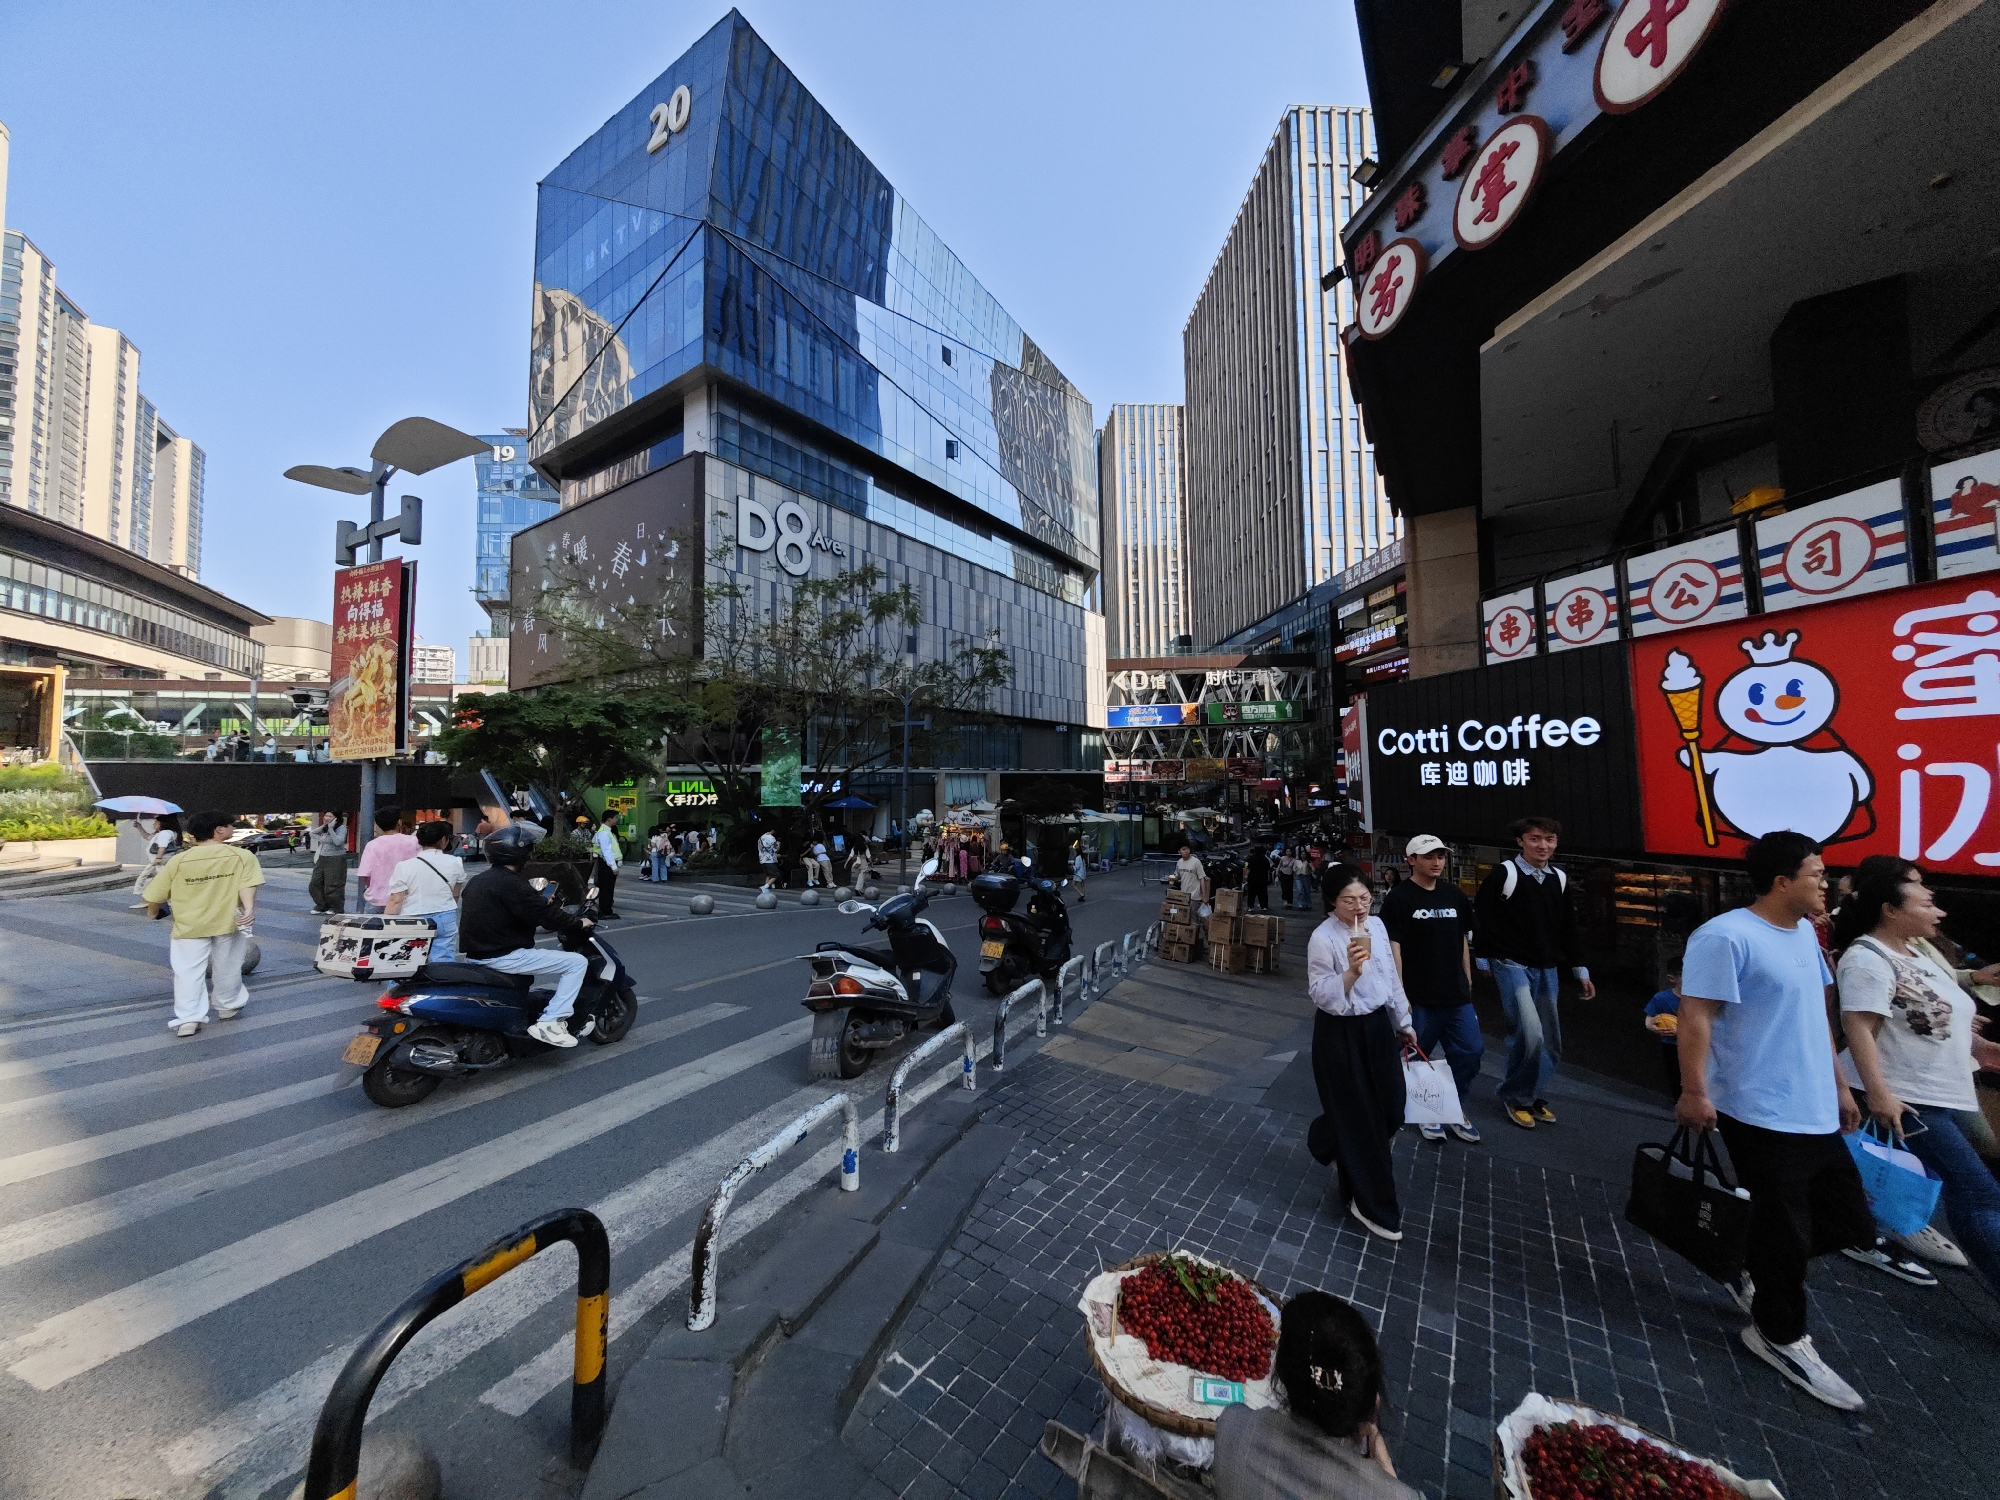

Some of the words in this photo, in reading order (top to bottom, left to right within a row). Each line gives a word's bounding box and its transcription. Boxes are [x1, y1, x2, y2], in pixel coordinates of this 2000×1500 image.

[647, 84, 691, 153] 20
[493, 446, 515, 462] 19
[737, 495, 812, 577] D8
[811, 527, 847, 558] Ave.
[611, 541, 632, 579] 春
[347, 598, 384, 622] 向得福
[336, 617, 393, 644] 香辣美蛙鱼
[1131, 670, 1167, 690] D馆
[1241, 704, 1277, 714] 四方朋友
[1377, 724, 1449, 756] Cotti
[1457, 713, 1602, 751] Coffee
[1420, 758, 1531, 787] 库迪咖啡
